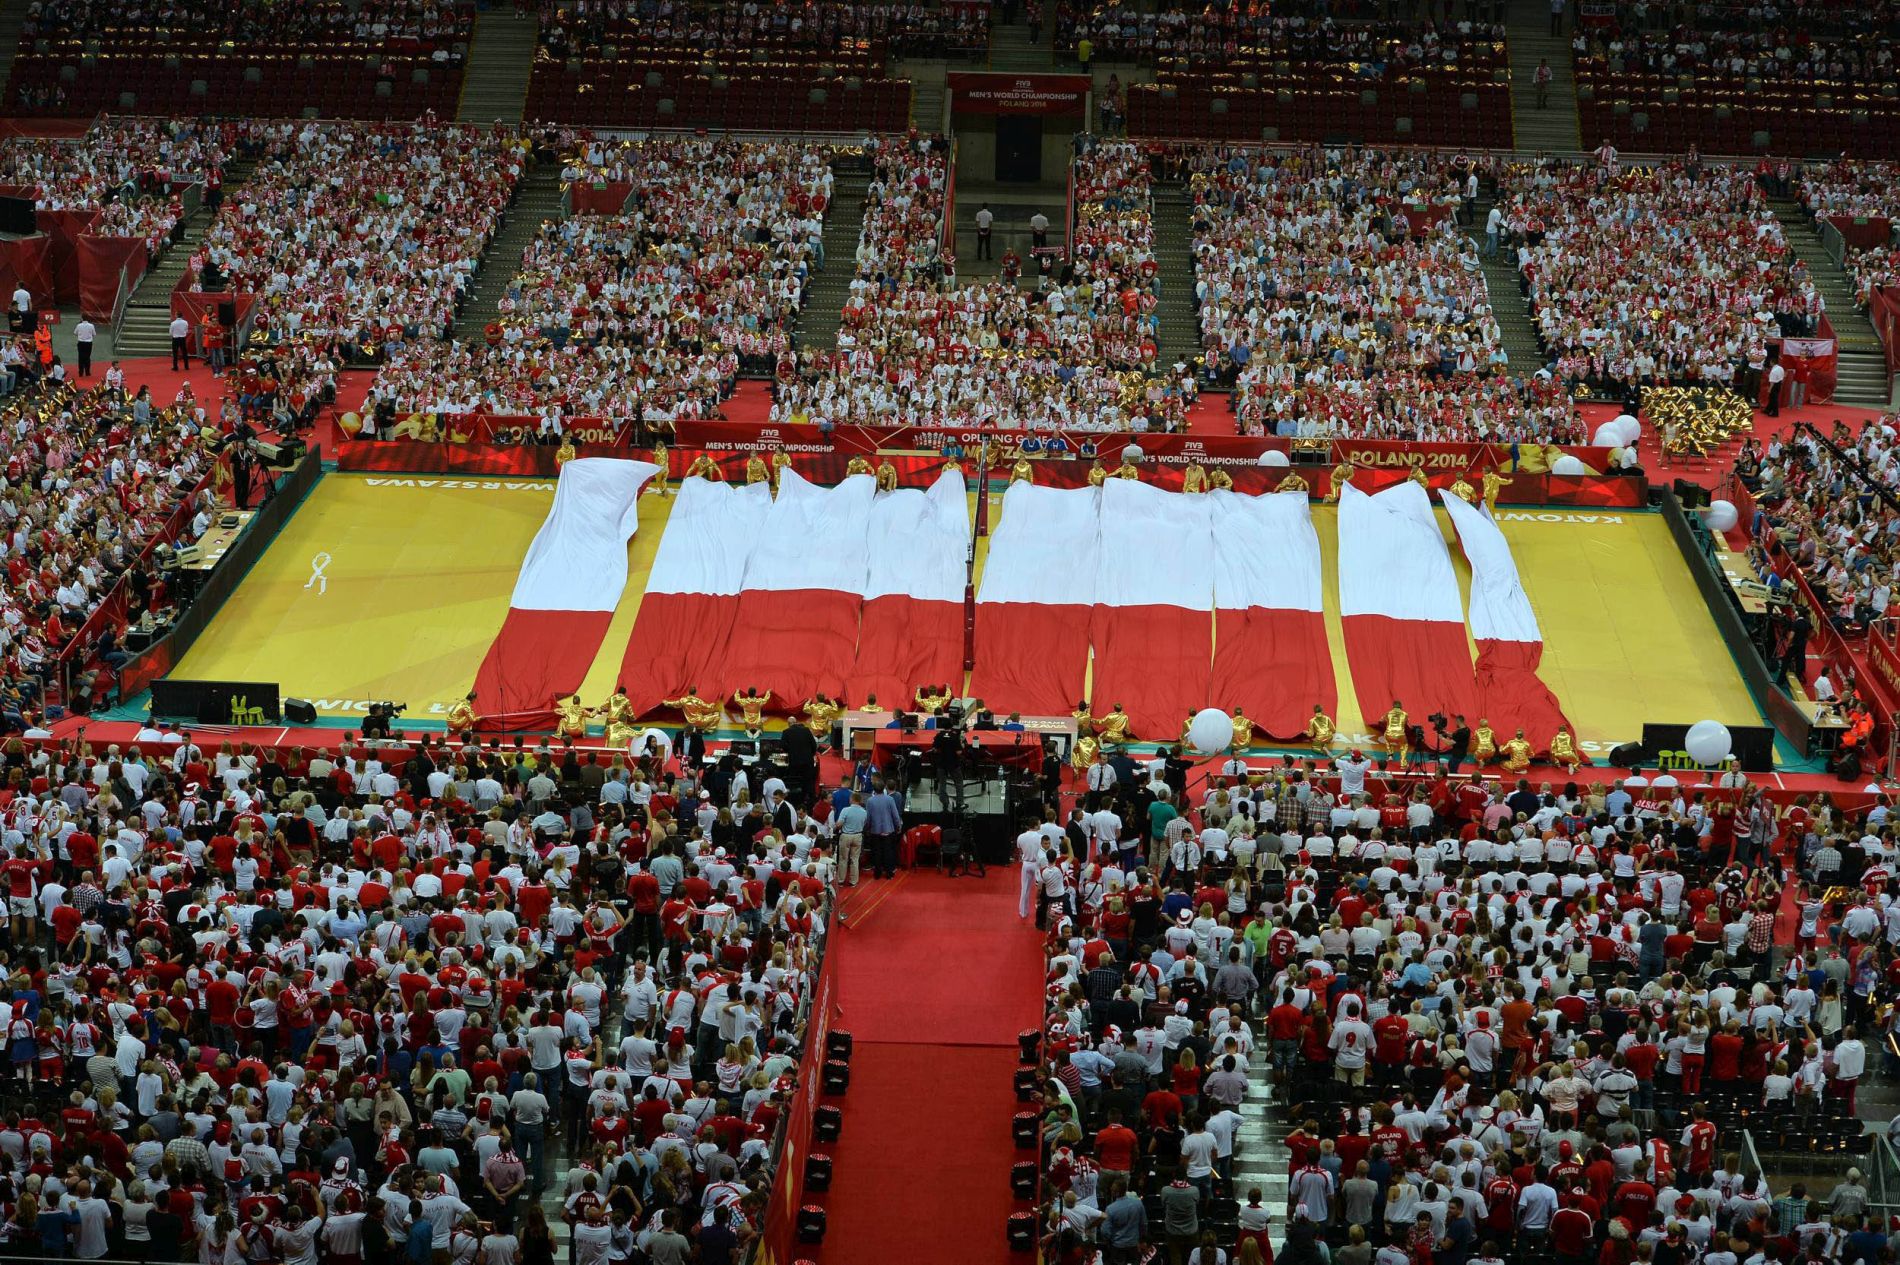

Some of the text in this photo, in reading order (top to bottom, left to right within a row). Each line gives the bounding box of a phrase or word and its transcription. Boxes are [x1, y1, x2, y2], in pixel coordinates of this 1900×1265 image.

[1021, 92, 1077, 100] CHAMPIONSHIP
[574, 428, 616, 443] 2014
[961, 433, 1048, 444] OPING GE
[705, 442, 732, 450] MEN'S
[734, 443, 766, 451] WORLD
[1158, 455, 1189, 463] WORLD
[1350, 450, 1468, 468] POLAND 2014
[364, 477, 555, 492] WARSZAWA
[1495, 512, 1623, 525] KATOWI
[1465, 785, 1483, 794] POLSKA
[20, 807, 26, 816] 8
[51, 811, 57, 821] 5
[1442, 842, 1454, 855] 2
[1278, 942, 1287, 955] 5
[1346, 1031, 1357, 1048] 9
[1146, 1041, 1153, 1054] 7
[596, 1094, 618, 1102] POLSKA
[1377, 1132, 1402, 1140] POLAND
[1700, 1136, 1707, 1150] 6
[1663, 1149, 1669, 1164] 6
[1558, 1167, 1579, 1176] POLSKA
[1625, 1193, 1649, 1201] POLSKA
